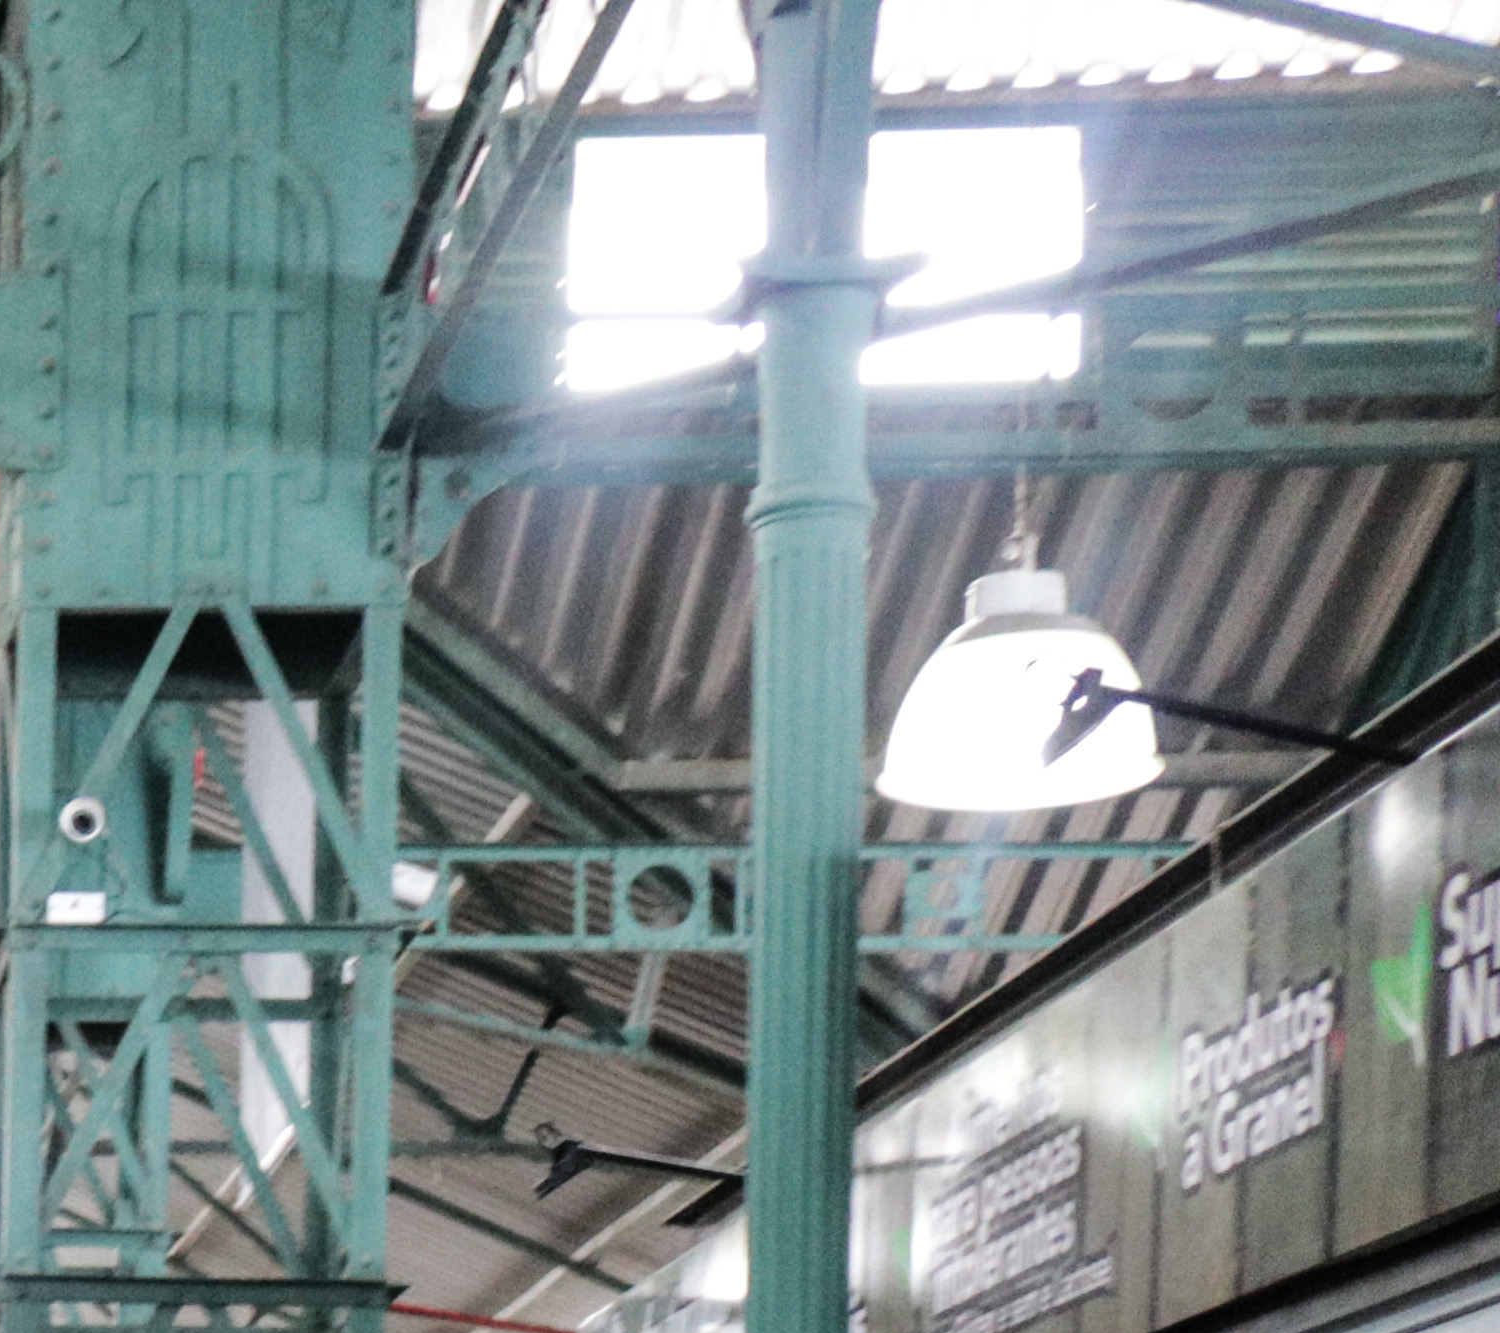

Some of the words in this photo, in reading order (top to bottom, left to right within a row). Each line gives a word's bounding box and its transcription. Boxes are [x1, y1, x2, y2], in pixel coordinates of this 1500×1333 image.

[1440, 872, 1500, 968] Su
[1181, 978, 1335, 1116] Produtos
[1181, 1131, 1203, 1190] a
[1209, 1039, 1326, 1175] Granel
[982, 1124, 1083, 1244] pessoas
